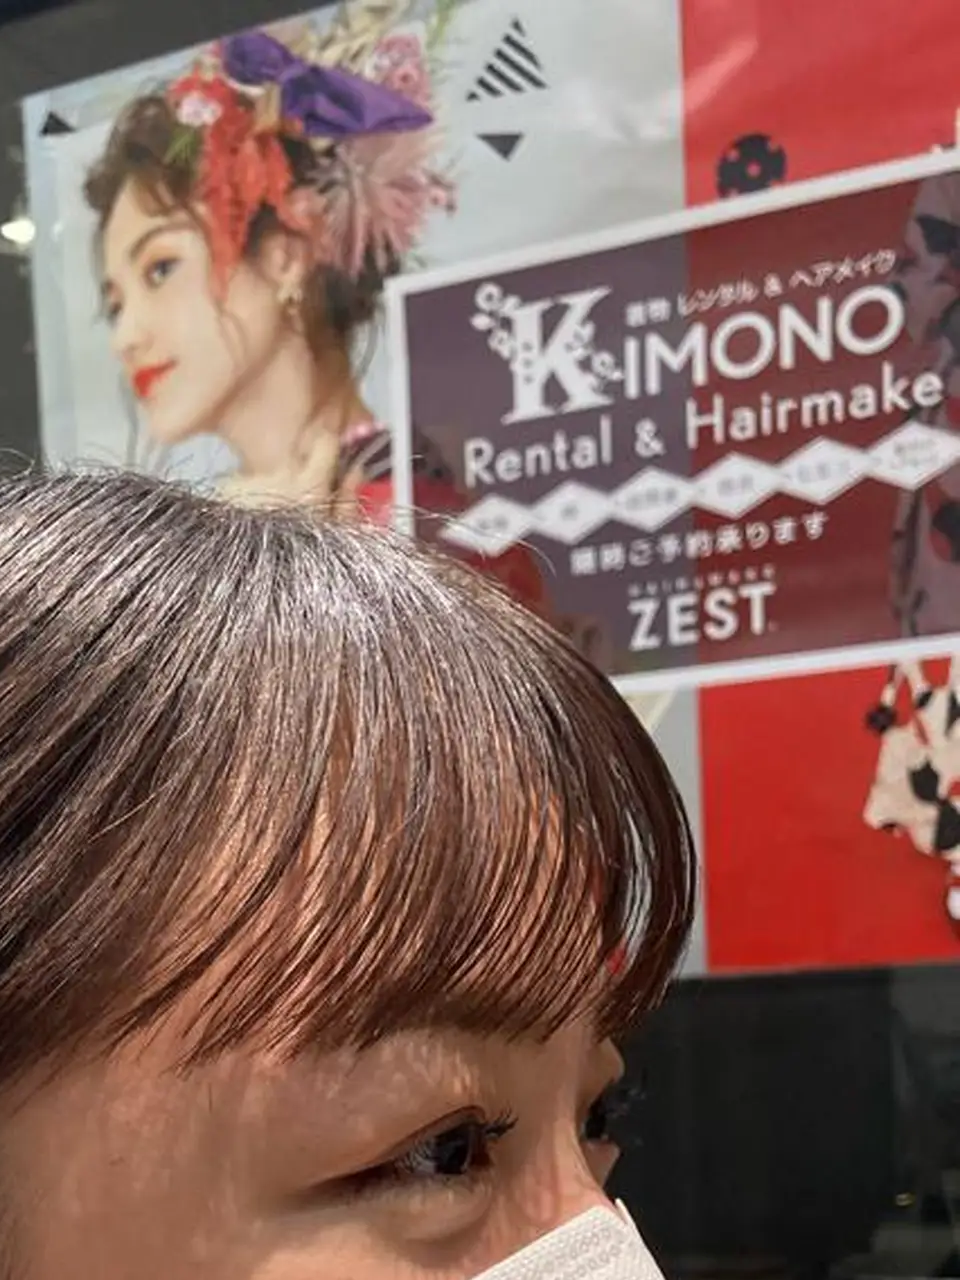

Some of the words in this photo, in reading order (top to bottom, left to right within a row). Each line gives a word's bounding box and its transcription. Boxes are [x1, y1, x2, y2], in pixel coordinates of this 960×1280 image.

[497, 284, 905, 425] KIMONO
[464, 416, 612, 488] Rental
[634, 418, 664, 457] &
[686, 361, 944, 448] Hairmake
[628, 581, 776, 651] ZEST
